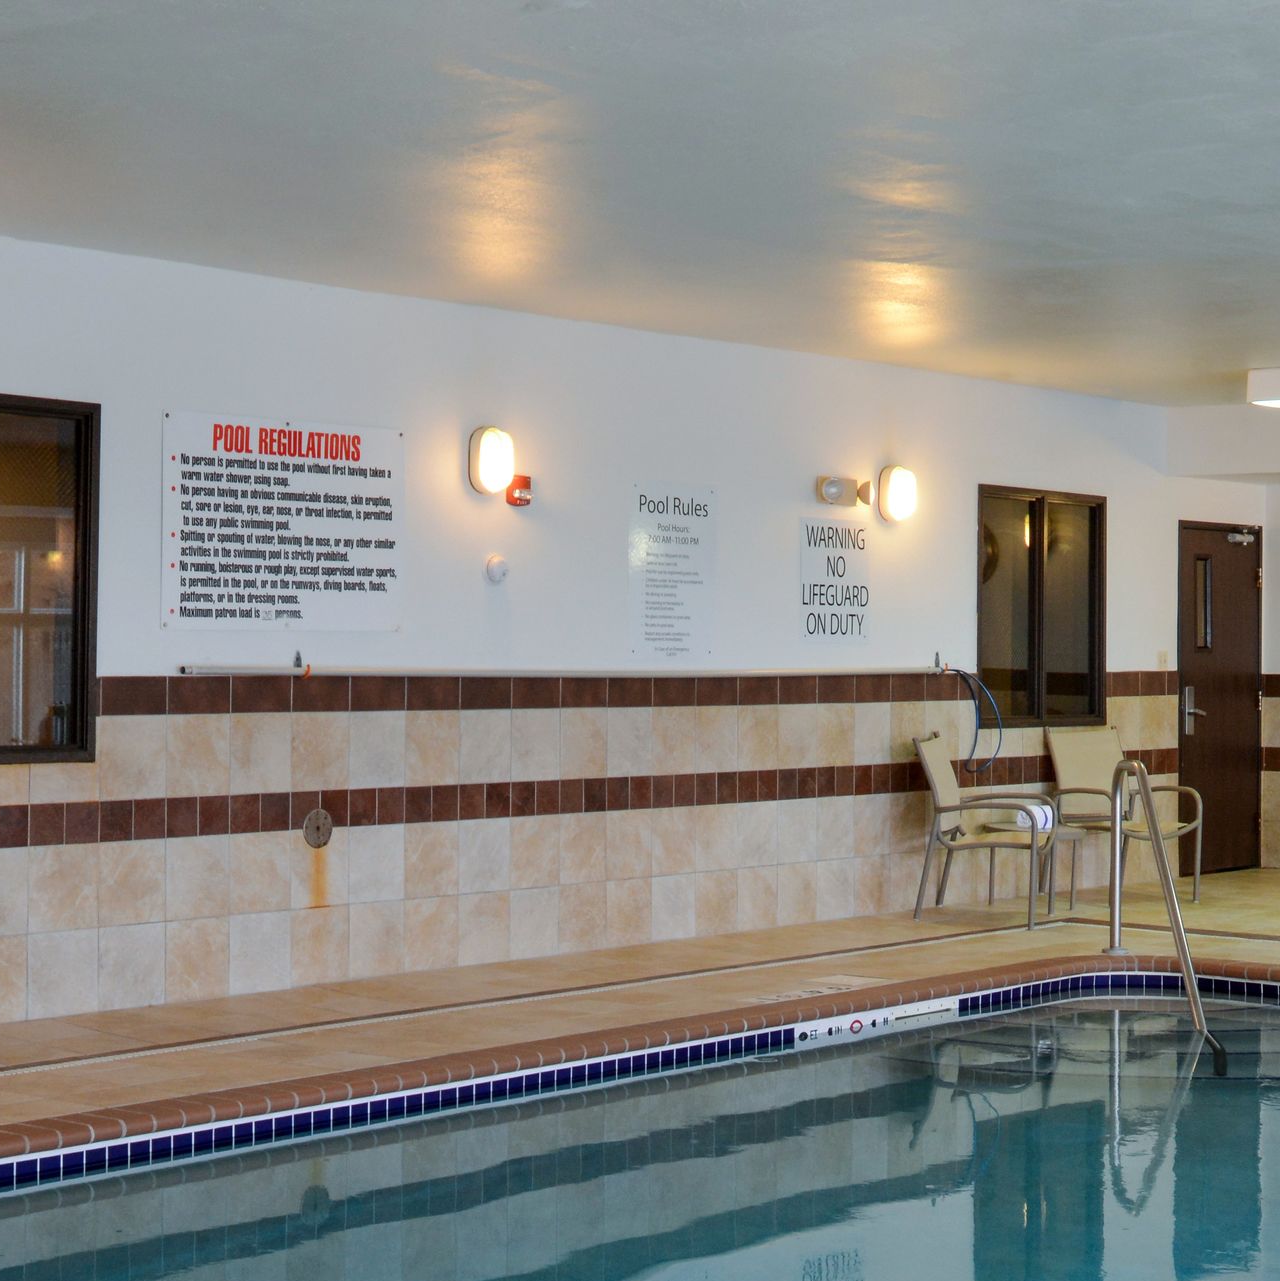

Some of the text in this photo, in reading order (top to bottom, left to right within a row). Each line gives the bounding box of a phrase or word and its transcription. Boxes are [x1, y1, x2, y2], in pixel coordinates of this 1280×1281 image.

[213, 423, 361, 462] POOL REGULATIONS
[180, 453, 390, 478] No person is permitted to use the pool without first having taken a
[181, 470, 289, 488] warm water shower, using soap.
[180, 484, 391, 508] No person having an obvious communicable disease, skin eruption,
[639, 494, 709, 518] Pool Rules
[181, 499, 392, 522] cut, sore or lesion, eye, ear, nose, or throat infection, is permitted
[183, 514, 290, 532] to use any public swimming pool.
[657, 523, 691, 534] Pool Hours:
[180, 529, 395, 549] Spitting or spouting of water, blowing the nose, or any other similar
[675, 536, 689, 545] 11:00
[689, 537, 699, 545] PM
[806, 525, 865, 550] WARNING
[180, 545, 349, 563] activities in the swimming pool is strictly prohibited.
[179, 560, 396, 579] No running, boisterous or rough play, except supervised water sports,
[826, 556, 846, 578] NO
[180, 575, 386, 592] is permitted in the pool, or on the runways, diving boards, floats,
[180, 590, 299, 605] platforms, or in the dressing rooms.
[802, 584, 869, 607] LIFEGUARD
[179, 606, 213, 617] Maximum
[214, 606, 236, 620] patron
[238, 607, 252, 618] load
[254, 607, 260, 618] is
[806, 612, 864, 635] ON DUTY
